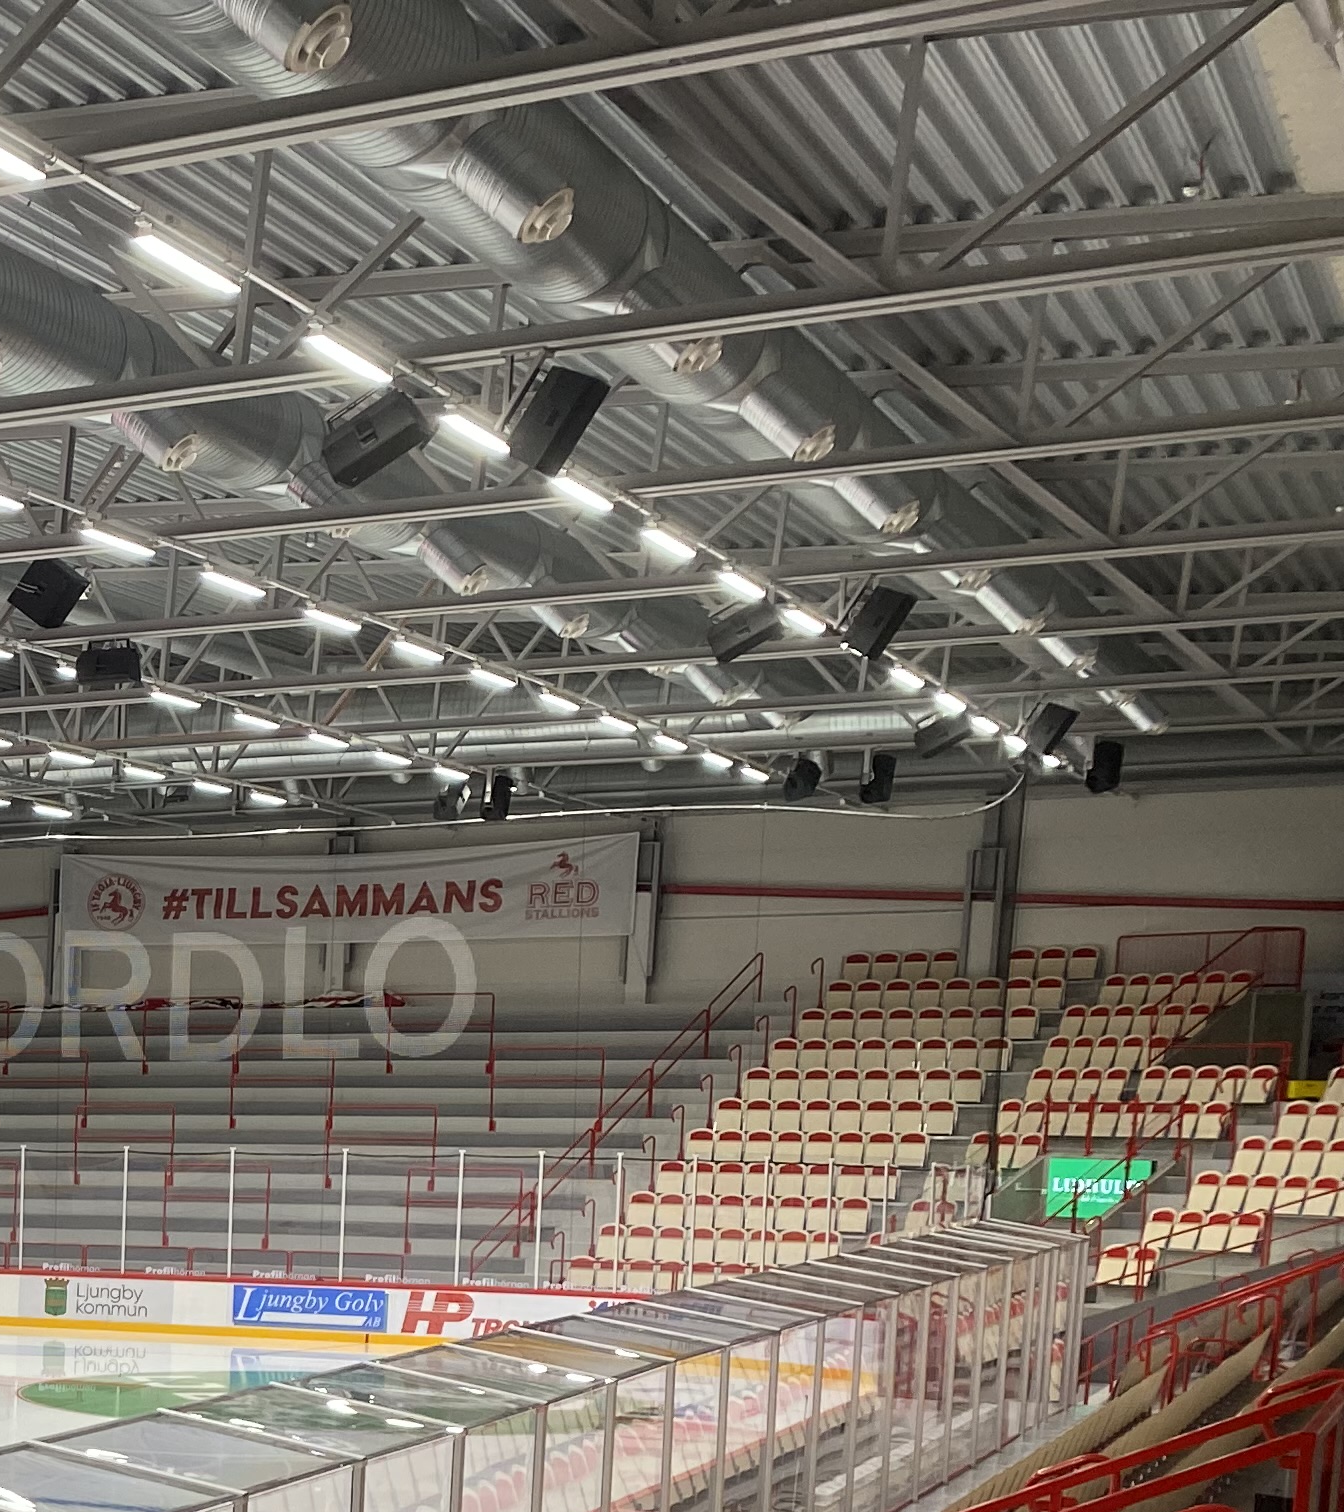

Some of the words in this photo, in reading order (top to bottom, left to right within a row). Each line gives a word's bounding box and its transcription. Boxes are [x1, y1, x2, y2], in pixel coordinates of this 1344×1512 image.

[162, 878, 505, 921] #TILLSAMMANS
[525, 880, 600, 908] RED
[525, 907, 600, 921] STALLIONS
[76, 1282, 144, 1303] Ljungby
[238, 1287, 329, 1322] Ljungby
[335, 1291, 384, 1314] Golv
[75, 1302, 148, 1317] kommun
[402, 1291, 475, 1335] HP
[364, 1316, 382, 1328] AB
